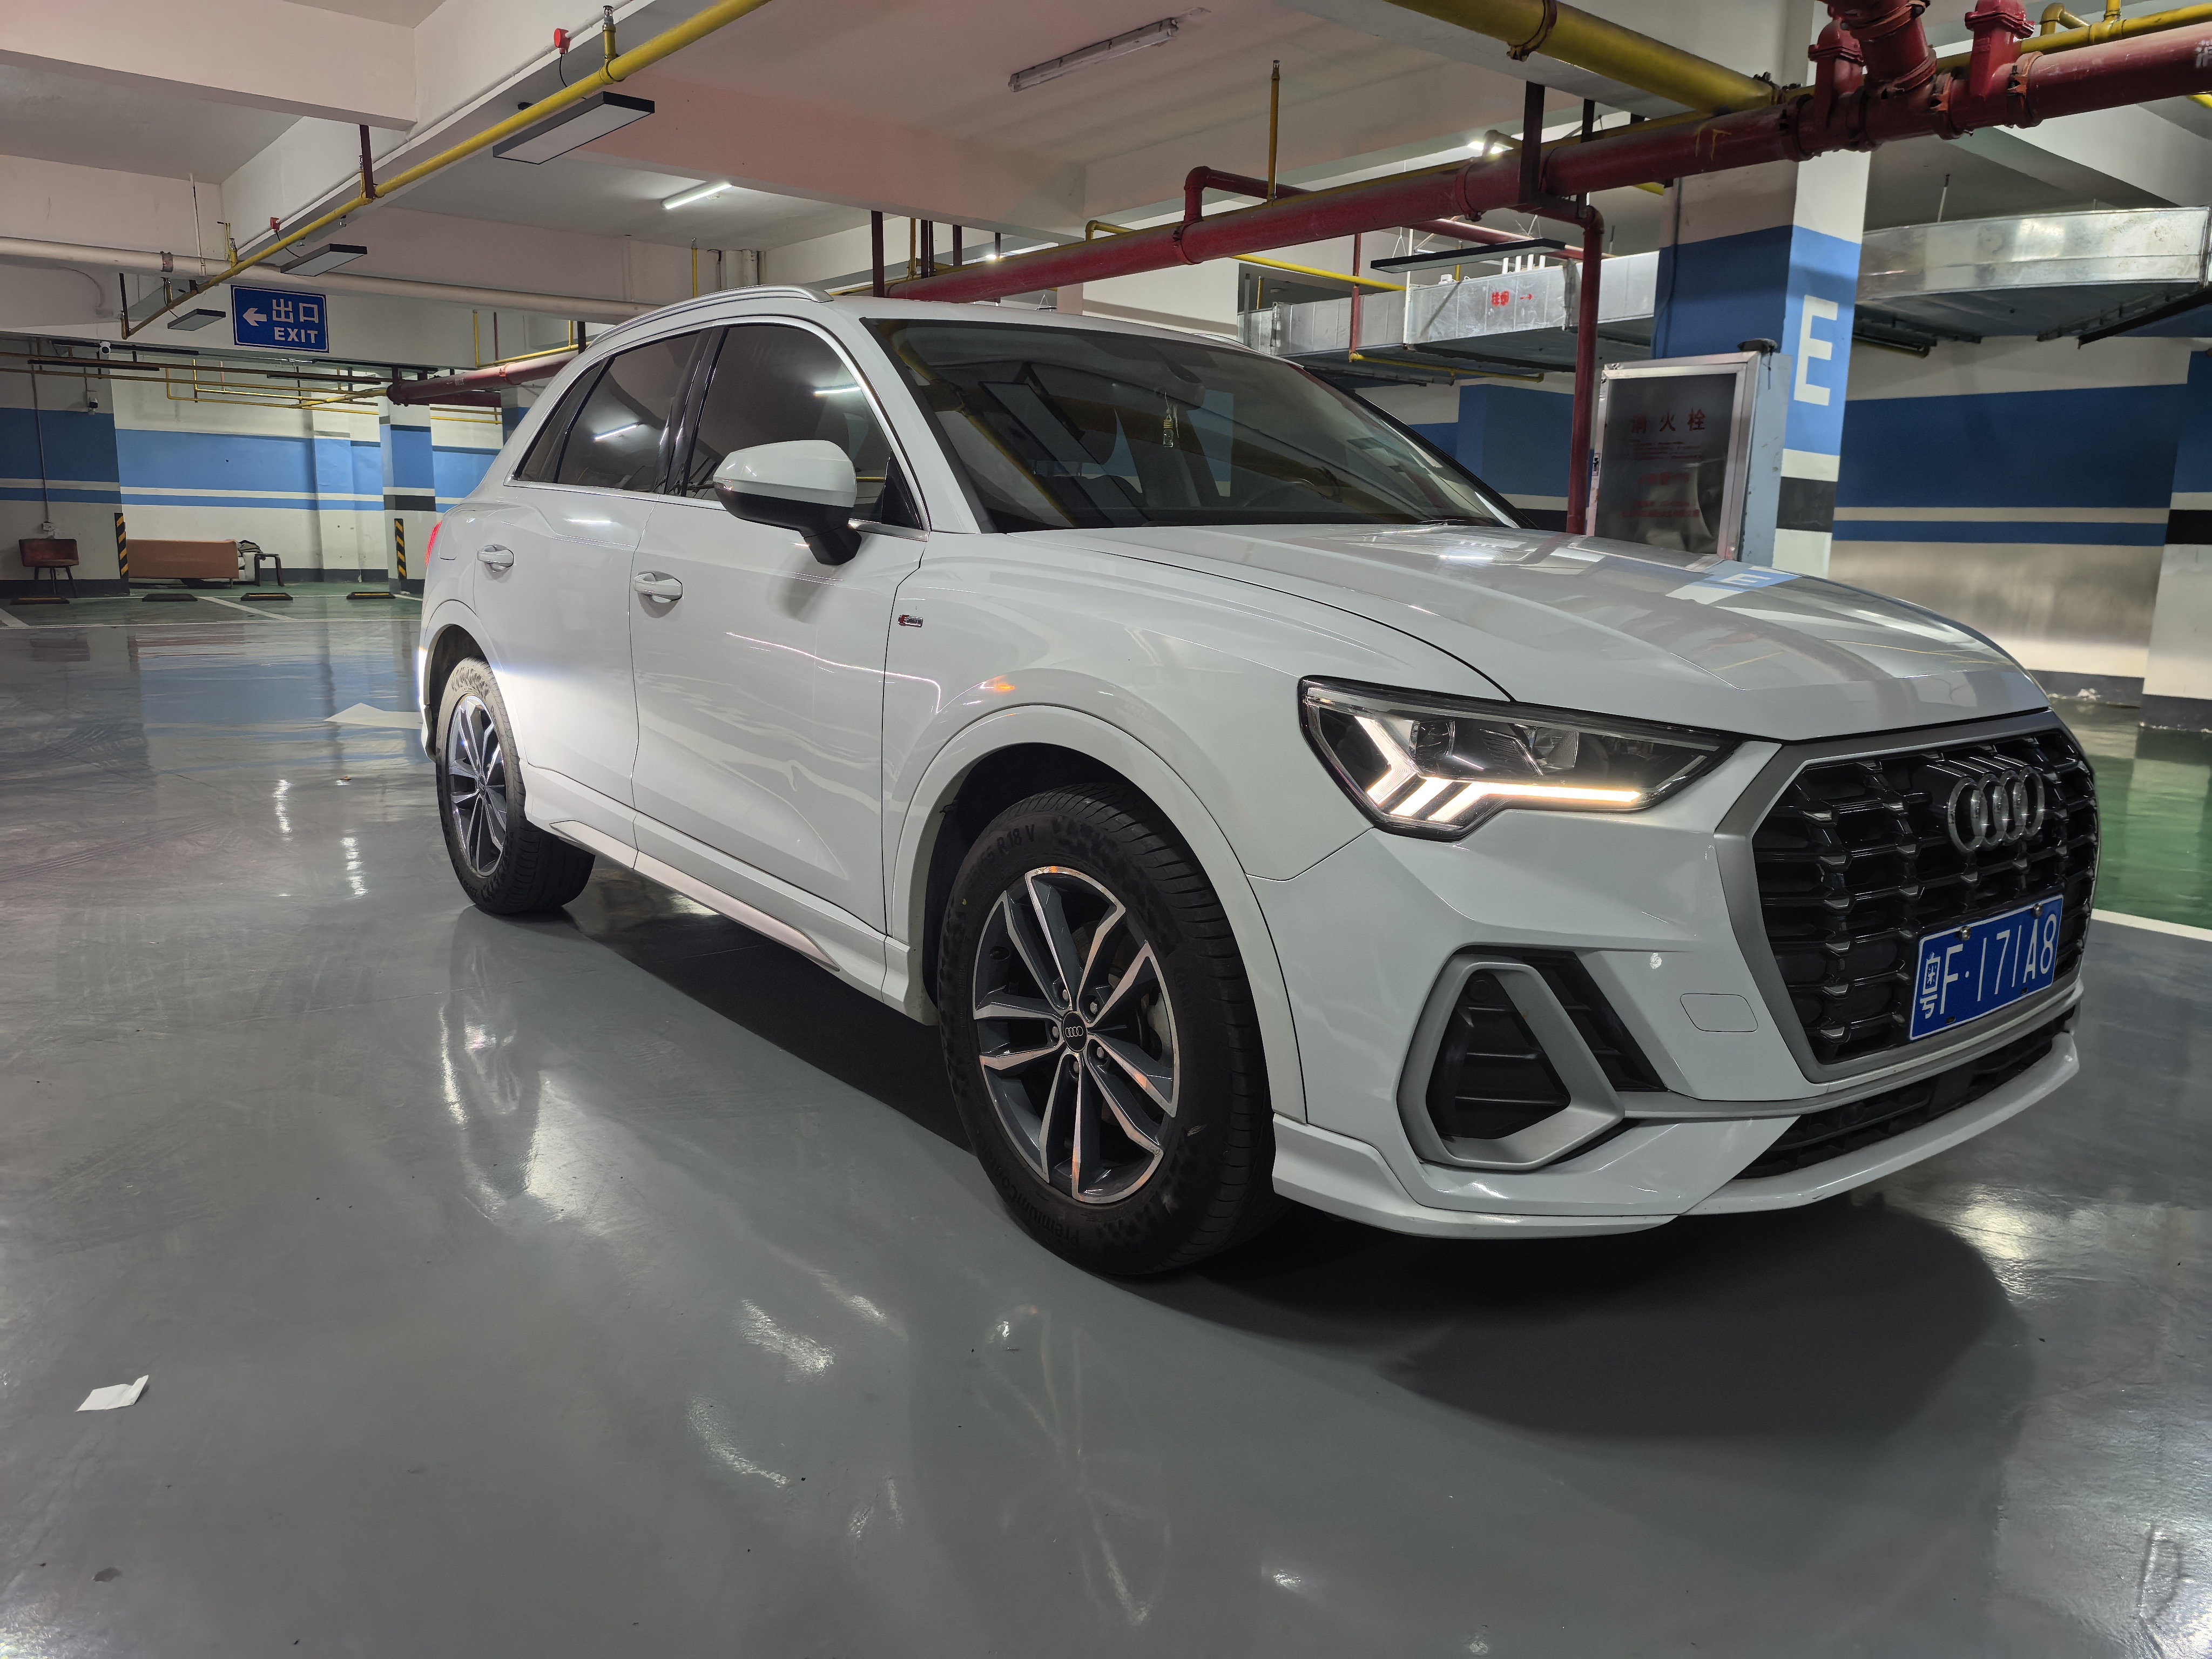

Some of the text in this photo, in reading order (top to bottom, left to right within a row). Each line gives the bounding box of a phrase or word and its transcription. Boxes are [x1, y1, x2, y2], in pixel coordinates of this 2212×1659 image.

[272, 299, 319, 323] 出口
[274, 327, 318, 343] EXIT
[1794, 295, 1838, 406] E
